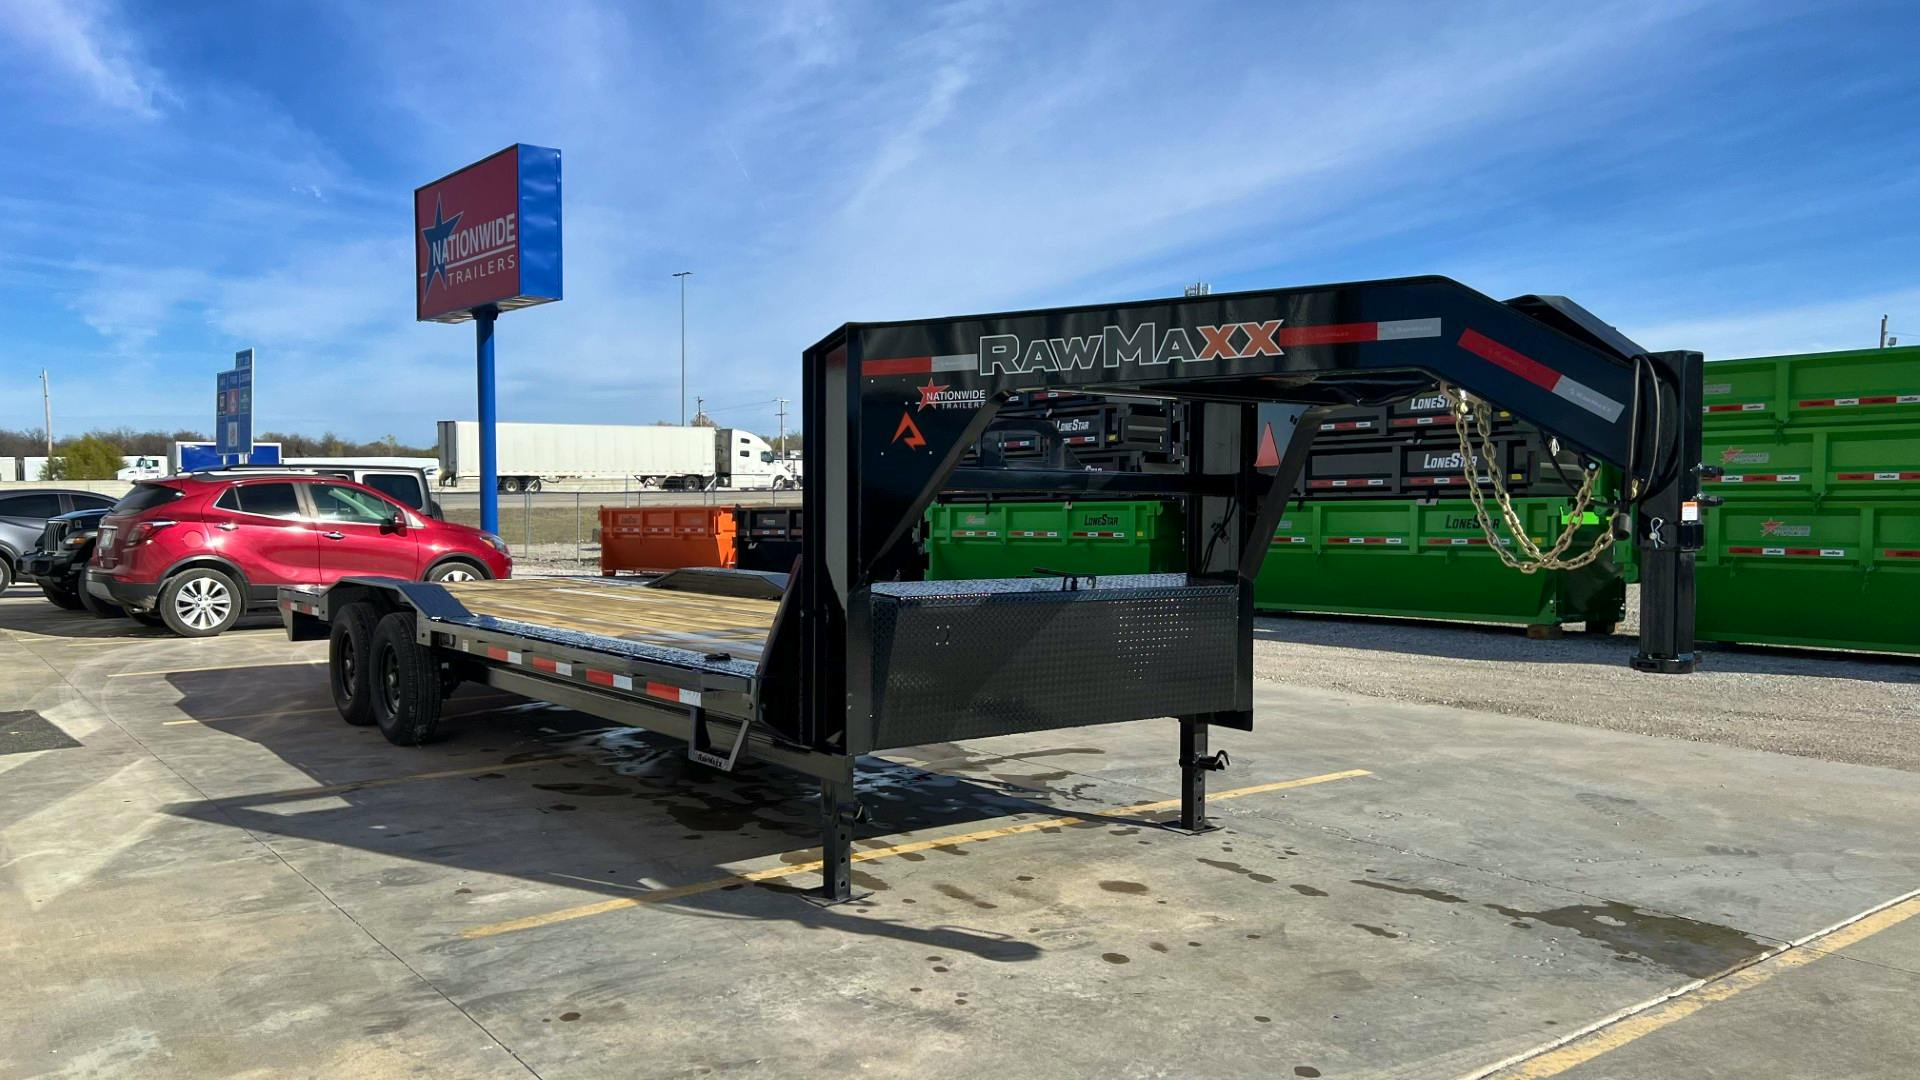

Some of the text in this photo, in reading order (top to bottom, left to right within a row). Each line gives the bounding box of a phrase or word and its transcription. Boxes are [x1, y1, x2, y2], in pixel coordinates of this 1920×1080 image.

[432, 213, 515, 266] NATIONWIDE
[447, 254, 515, 286] TRAILERS
[926, 389, 986, 401] NATIONWIDE
